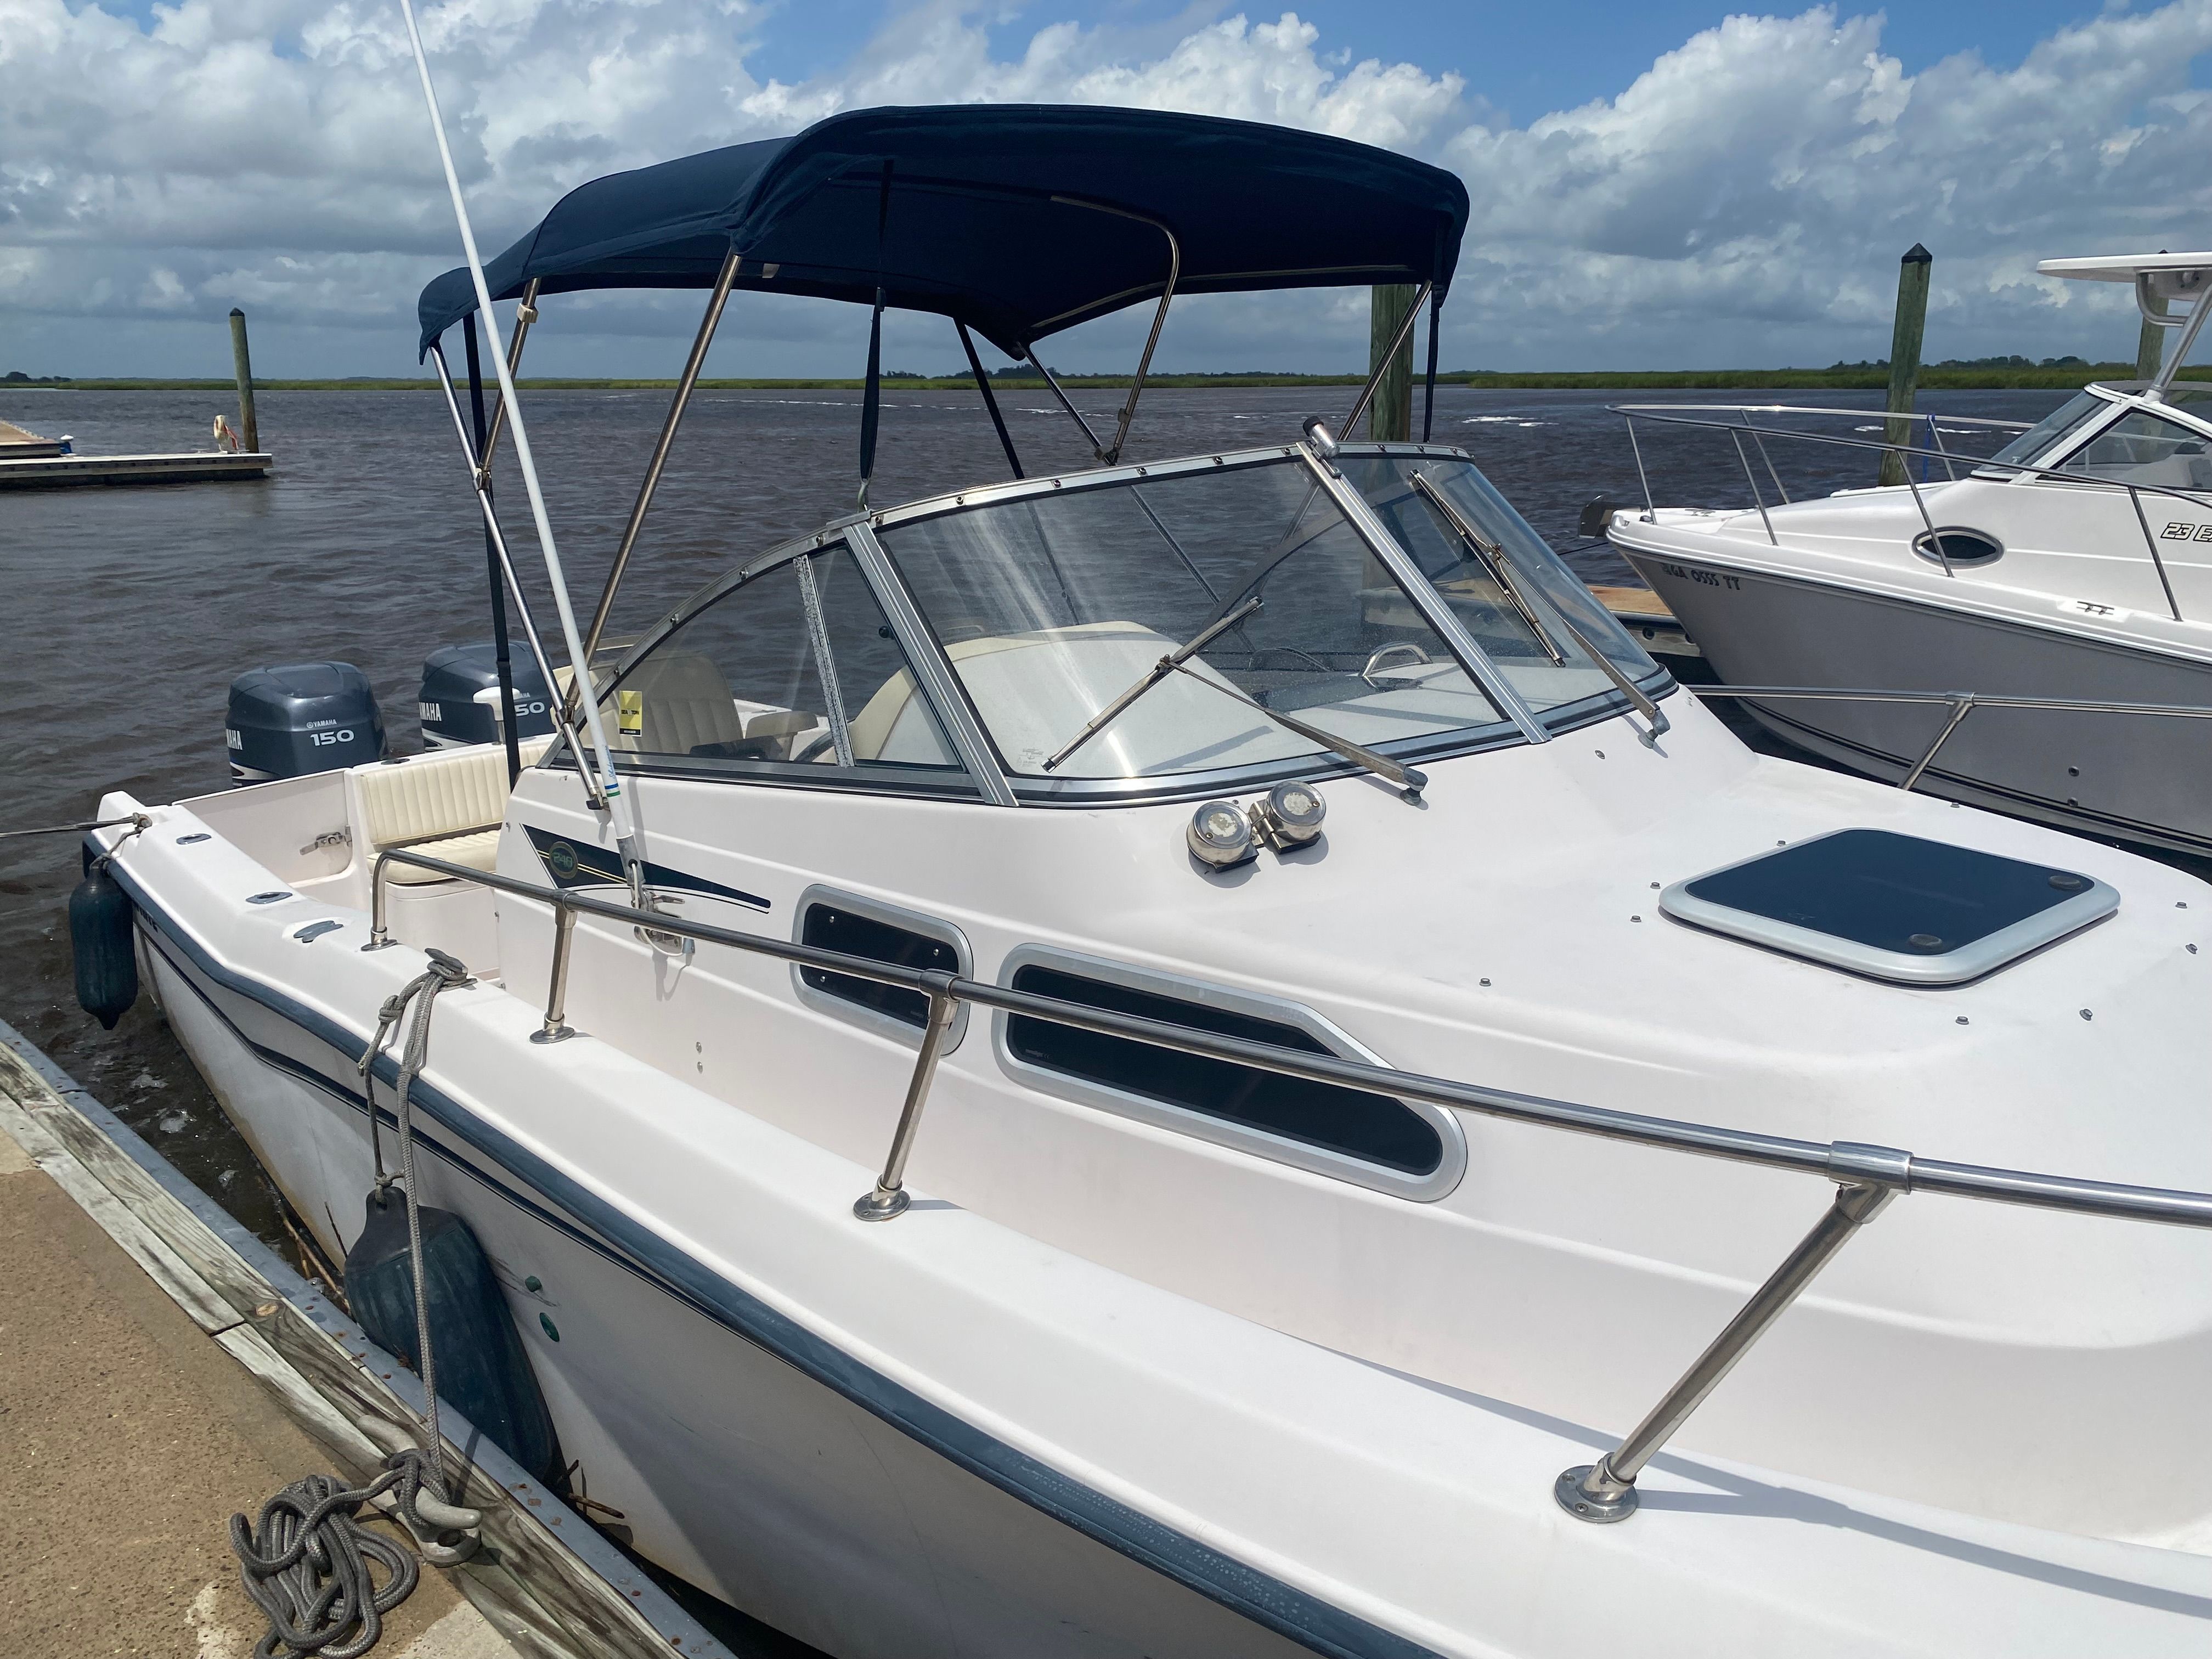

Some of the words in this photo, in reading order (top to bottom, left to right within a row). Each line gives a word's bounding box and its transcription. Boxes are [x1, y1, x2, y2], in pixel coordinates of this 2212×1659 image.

[2160, 522, 2195, 540] 23
[2193, 525, 2212, 543] E
[1723, 576, 1740, 590] TT
[514, 702, 545, 717] 50
[313, 719, 337, 727] YAMAHA
[310, 729, 354, 746] 150
